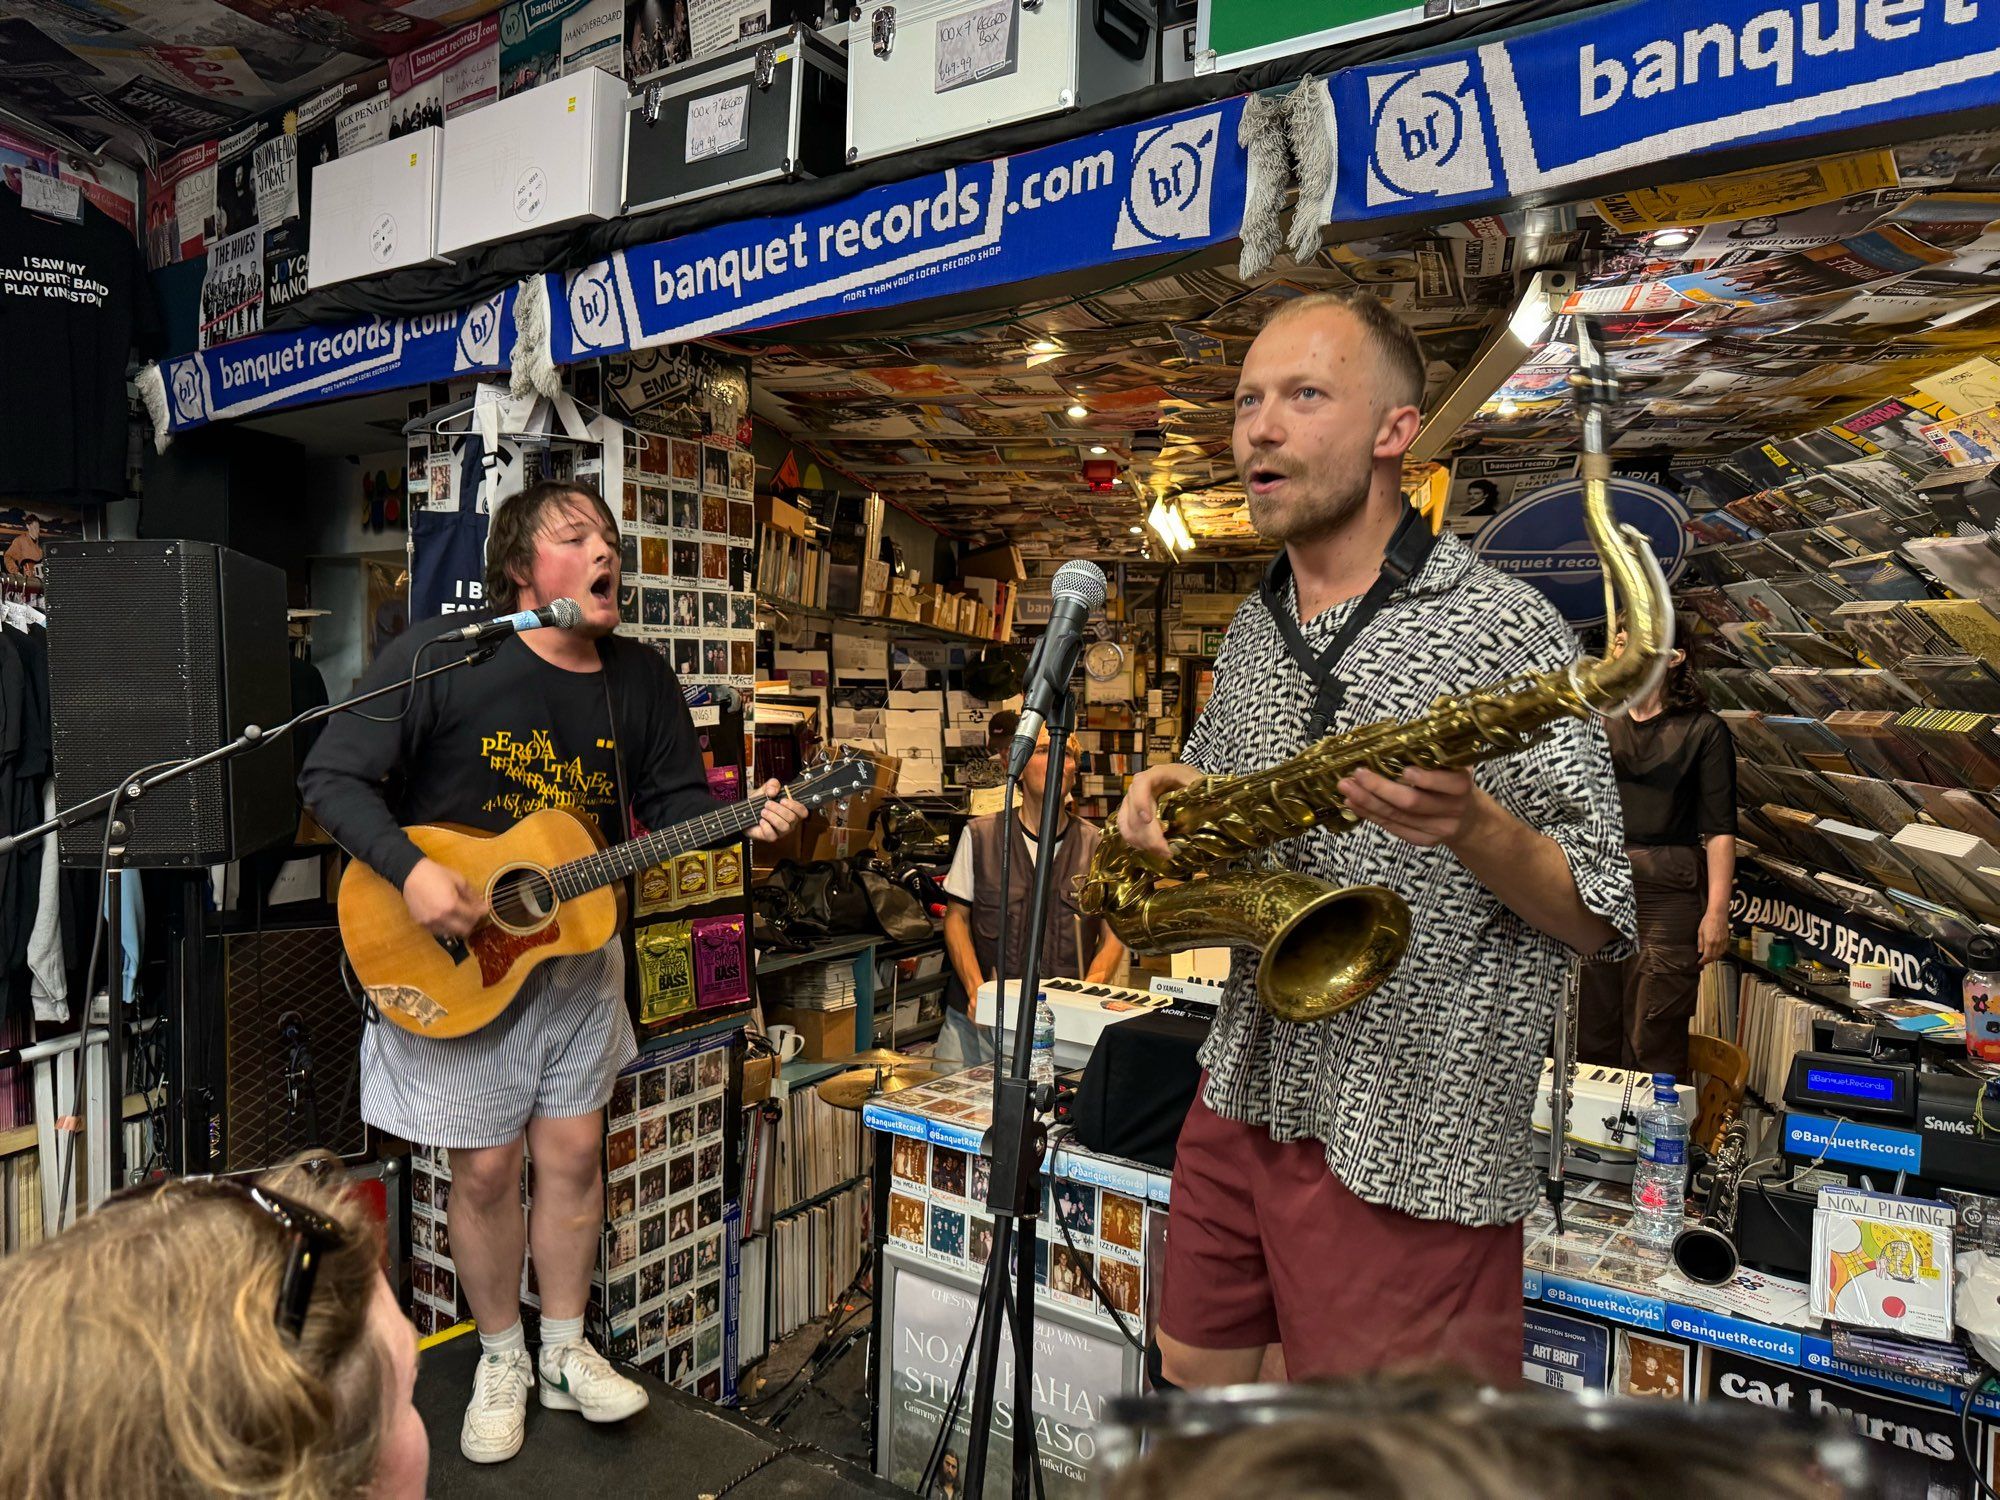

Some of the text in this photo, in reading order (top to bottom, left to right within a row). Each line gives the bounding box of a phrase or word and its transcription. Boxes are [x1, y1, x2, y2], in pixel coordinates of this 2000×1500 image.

[977, 12, 1008, 33] RECORD
[416, 43, 448, 68] banquet
[449, 31, 477, 52] records
[979, 28, 1000, 47] BOX
[298, 97, 322, 119] banquet
[322, 87, 343, 110] records
[337, 97, 390, 132] JACK PEÑATE
[721, 95, 743, 111] RECORD
[219, 138, 242, 154] banquet
[241, 127, 259, 146] records
[258, 159, 295, 193] JACKET
[653, 222, 808, 306] banquet
[819, 168, 979, 264] records
[214, 232, 257, 267] THE HIVES
[23, 256, 28, 267] I
[32, 257, 65, 274] SAW
[843, 246, 1002, 304] MORE THAN YOUR LOCAL RECORD SHOP
[5, 282, 39, 298] PLAY
[73, 277, 109, 296] BAND
[220, 338, 304, 390] banquet
[310, 313, 392, 367] records
[1489, 461, 1524, 472] banquet
[1525, 459, 1555, 470] records
[1529, 473, 1559, 481] KING
[1742, 895, 1832, 951] BANQUET
[659, 974, 689, 990] BASS
[715, 966, 740, 982] BASS
[1163, 984, 1185, 995] YAMAHA
[1160, 1007, 1187, 1018] MORE
[1809, 1073, 1887, 1092] @BanquetRecords
[865, 1114, 925, 1135] @BanquetRecords
[1791, 1128, 1917, 1158] @BanquetRecords
[1069, 1164, 1145, 1190] @BanquetRecords
[1828, 1195, 1868, 1214] NOW
[1547, 1288, 1660, 1321] @BanquetRecords
[1053, 1329, 1092, 1352] VINYL
[1534, 1324, 1587, 1342] KINGSTON SHOWS
[1671, 1318, 1795, 1356] @BanquetRecords
[1532, 1343, 1580, 1368] ART BRUT
[1807, 1353, 1946, 1393] @BanquetRecords
[1719, 1372, 1795, 1412] cat
[904, 1400, 938, 1425] Grammy
[1064, 1465, 1087, 1483] Gold
